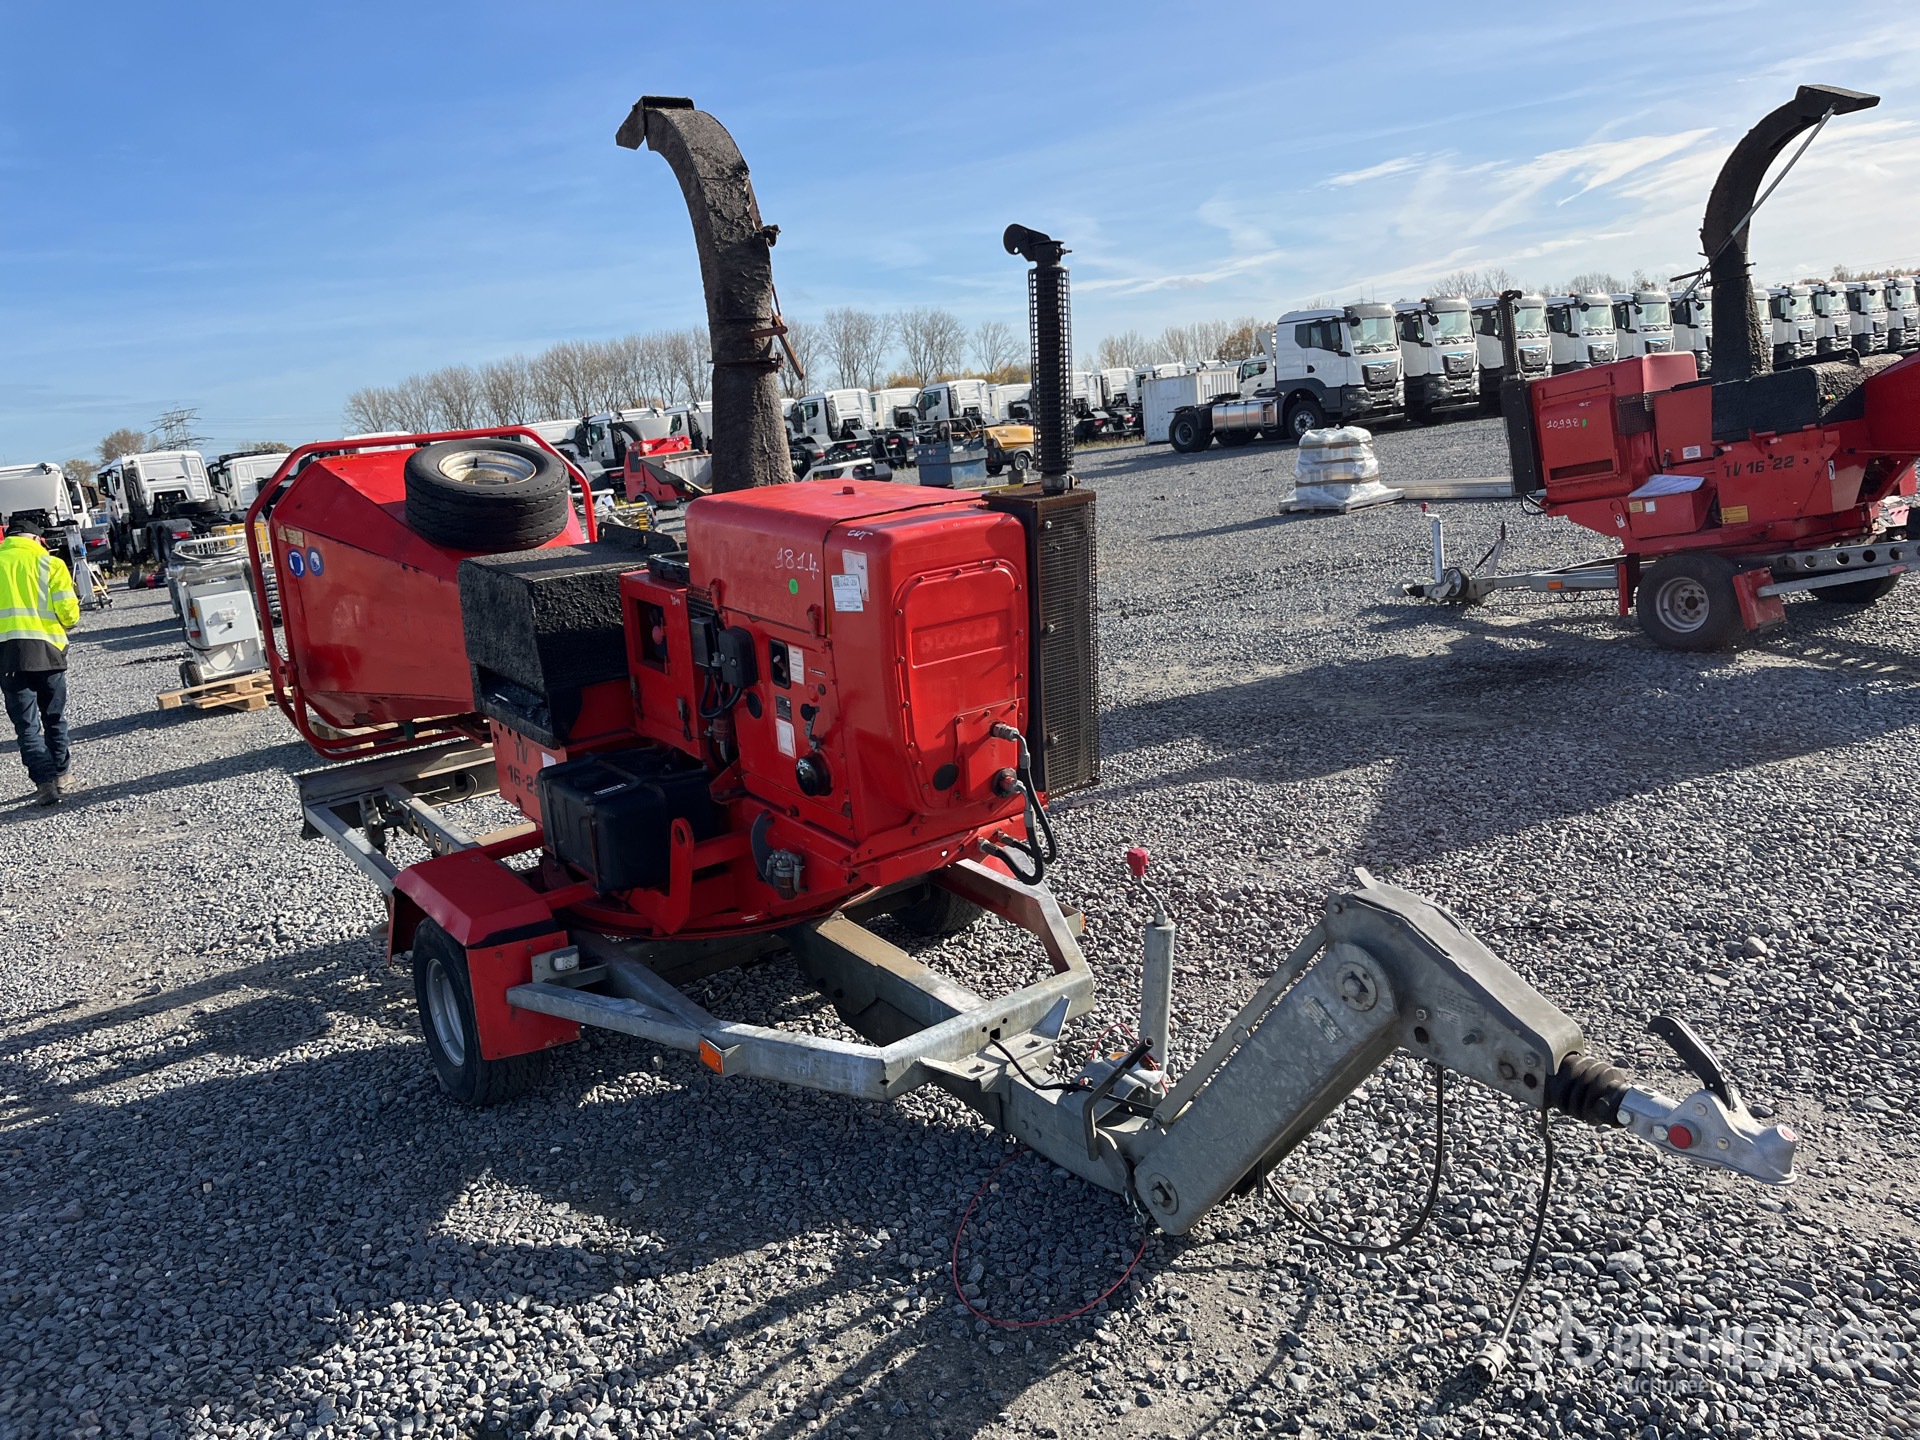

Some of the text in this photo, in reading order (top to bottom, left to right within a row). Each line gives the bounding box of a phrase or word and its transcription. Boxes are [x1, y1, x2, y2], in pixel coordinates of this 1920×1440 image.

[1547, 418, 1579, 429] 10998
[1724, 461, 1742, 477] TV
[514, 741, 528, 765] TV
